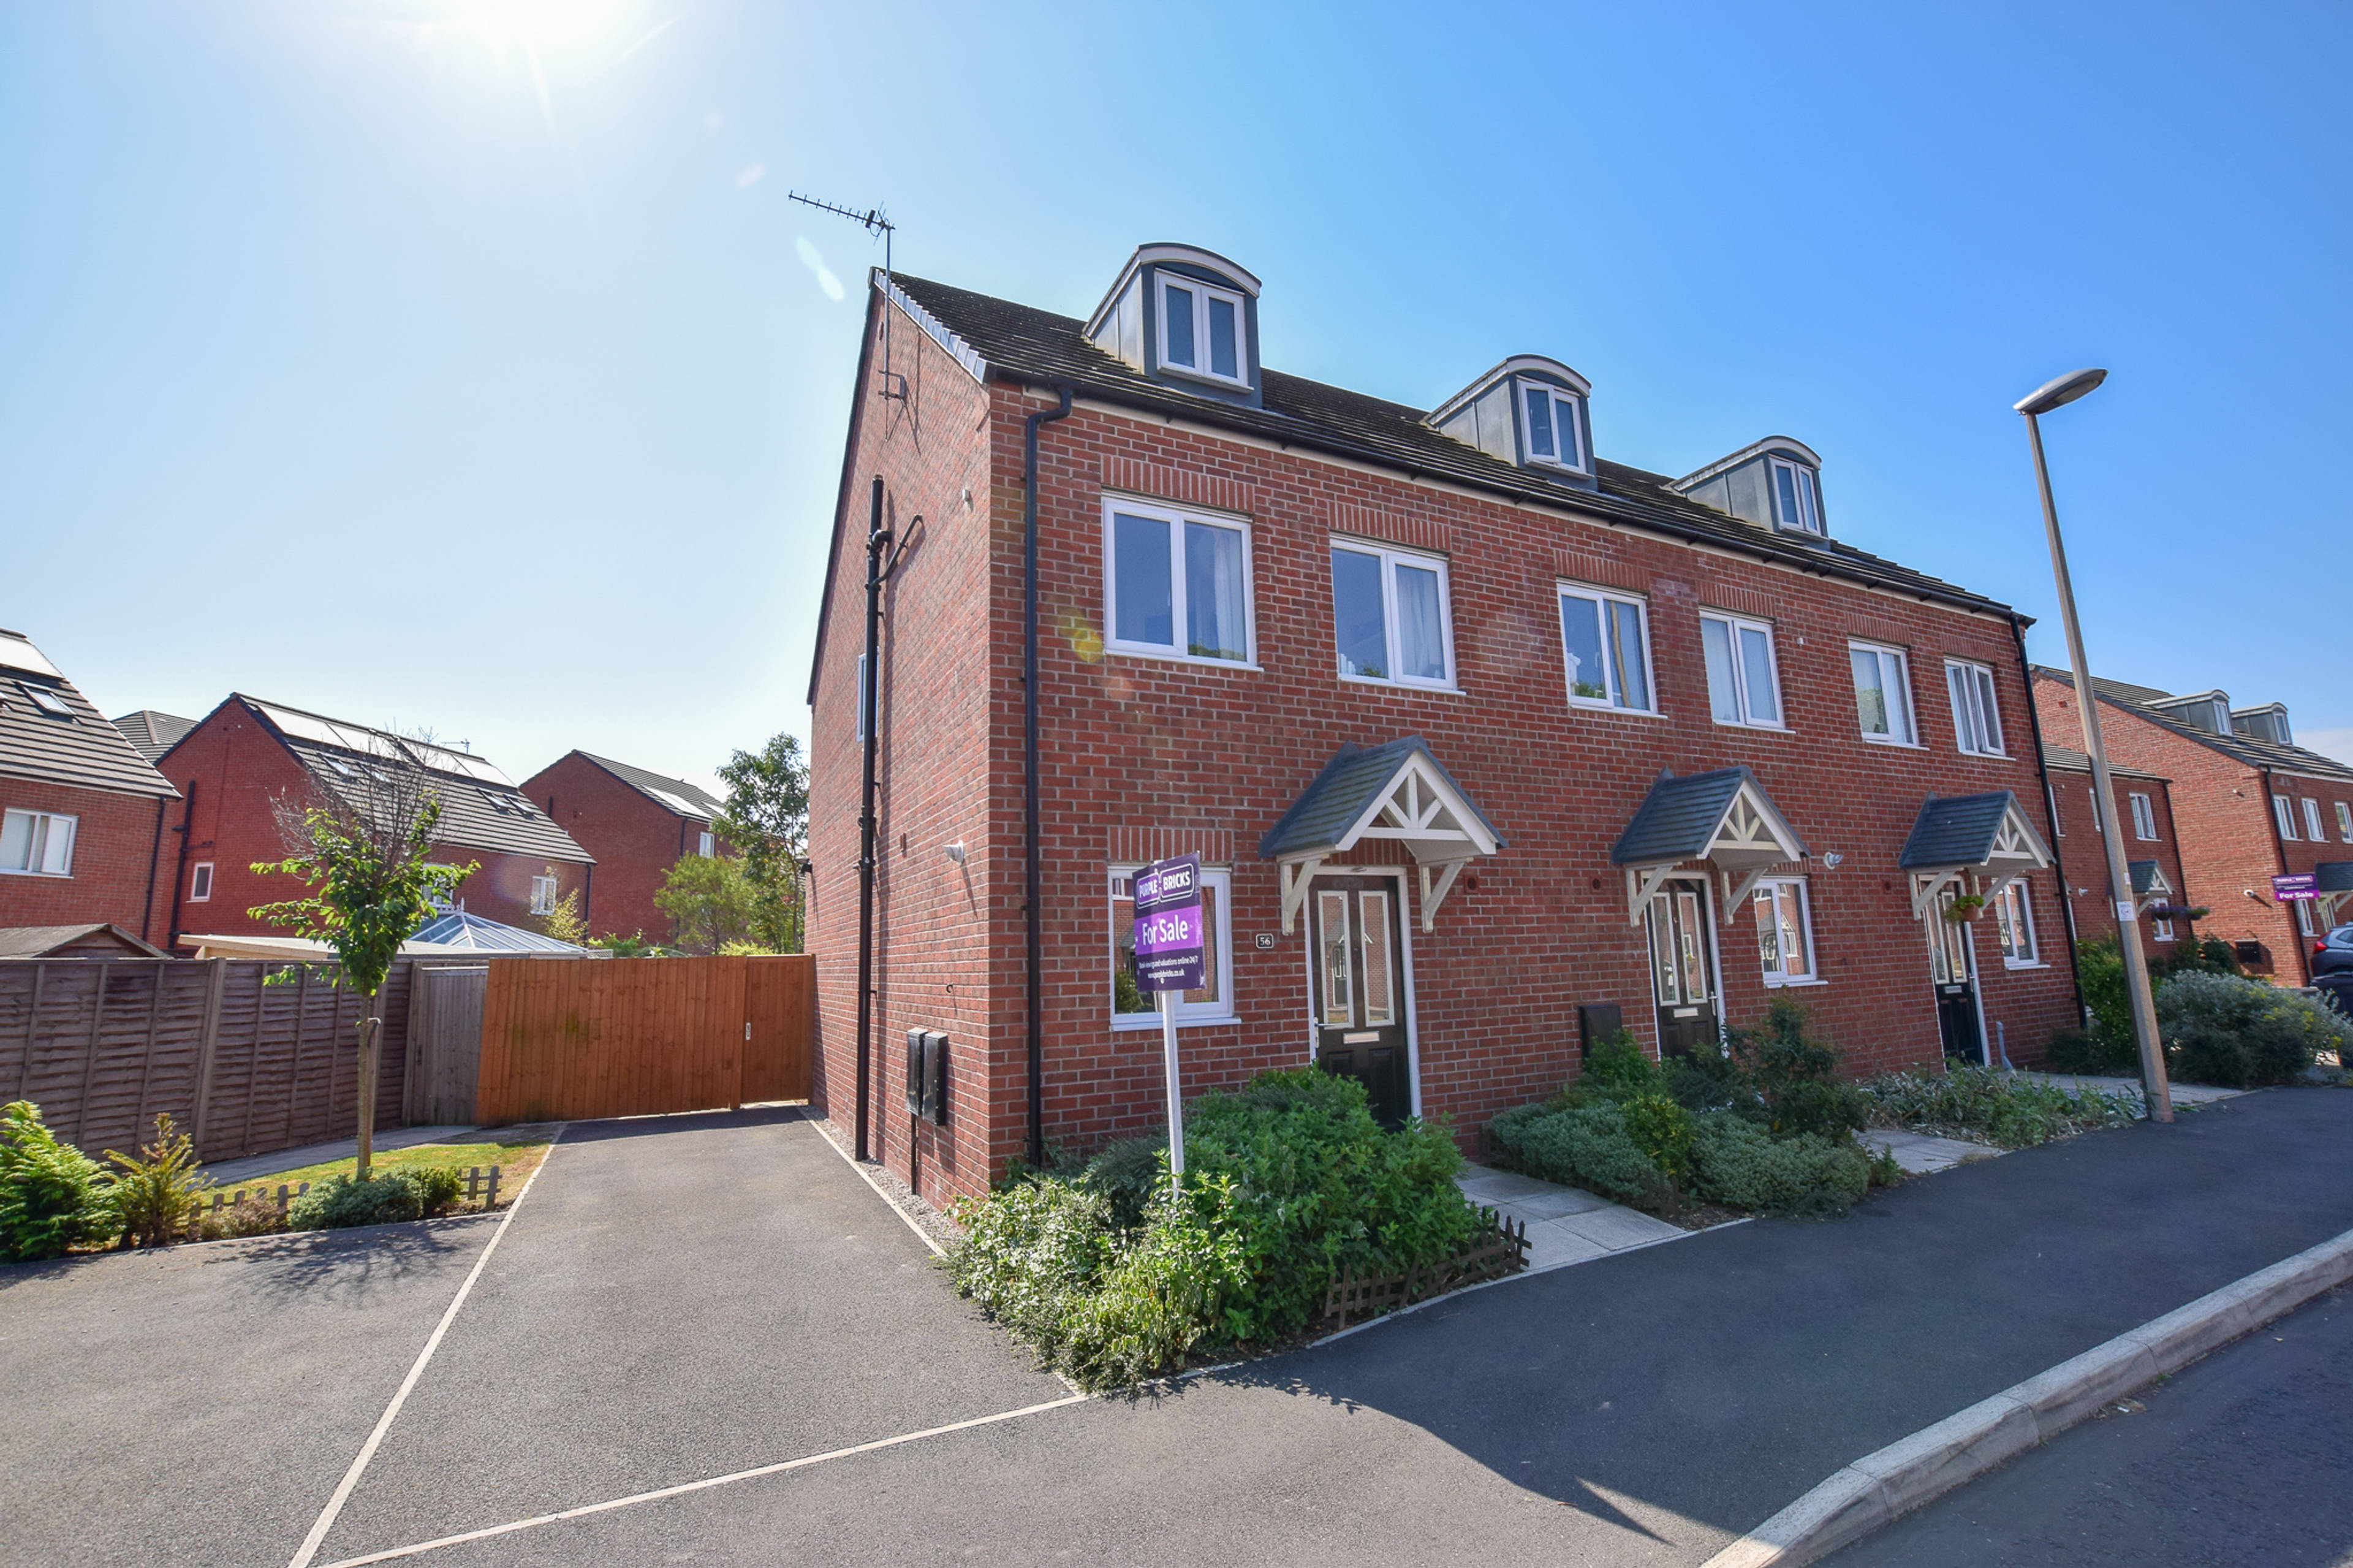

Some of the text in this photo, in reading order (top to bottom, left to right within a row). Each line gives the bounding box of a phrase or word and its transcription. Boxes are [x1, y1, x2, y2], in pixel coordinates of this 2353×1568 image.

[1139, 871, 1191, 898] PURPLE BRICKS
[1142, 914, 1188, 946] For Sale
[1260, 937, 1271, 945] 56
